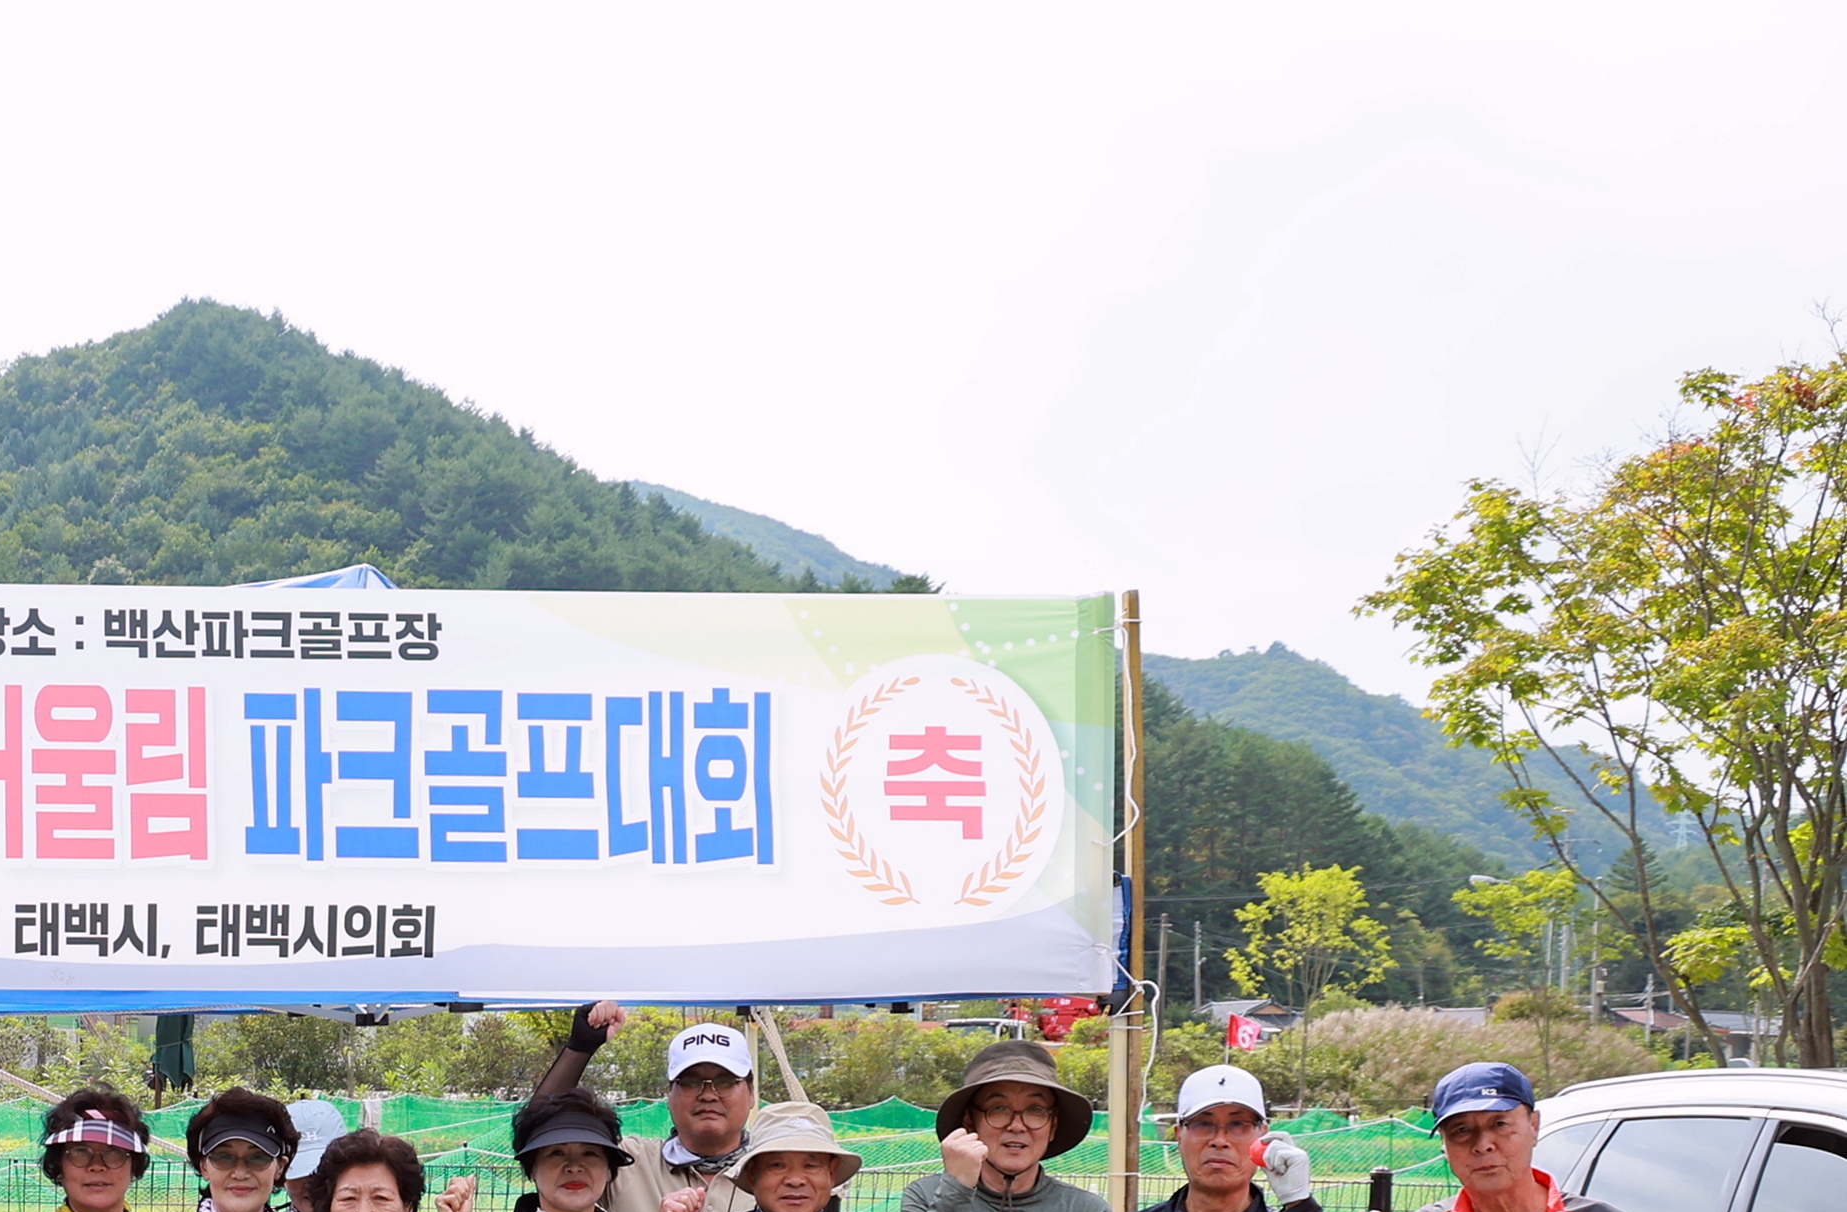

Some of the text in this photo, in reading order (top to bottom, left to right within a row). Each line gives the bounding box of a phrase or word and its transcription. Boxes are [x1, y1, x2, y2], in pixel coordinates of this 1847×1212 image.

[104, 609, 442, 661] 백산파크골프장
[243, 687, 774, 865] 파크골프대회
[883, 726, 987, 840] 축
[15, 902, 171, 960] 태백시,
[196, 904, 436, 960] 태백시의회
[683, 1034, 731, 1051] PING
[1481, 1088, 1498, 1096] K2
